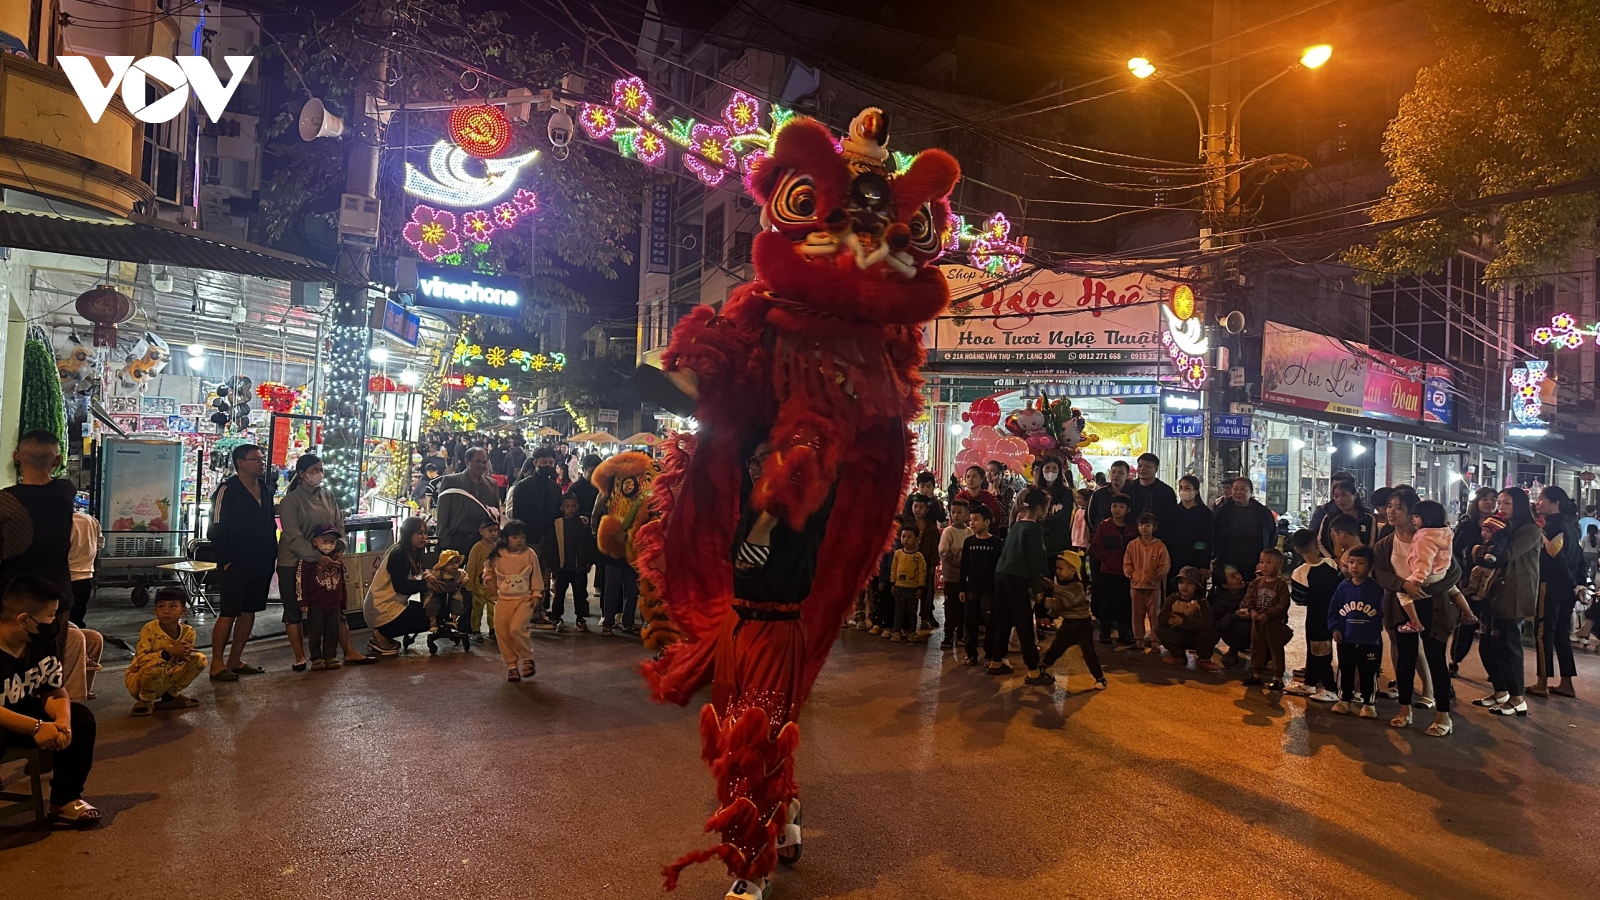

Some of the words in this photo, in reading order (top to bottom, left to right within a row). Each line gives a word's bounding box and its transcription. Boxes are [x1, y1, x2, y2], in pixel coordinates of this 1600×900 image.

[946, 268, 976, 283] Shop
[419, 275, 519, 307] vinaphone
[956, 279, 1064, 330] Ngọc
[1077, 273, 1144, 318] Huế
[959, 331, 997, 346] Hoa
[1002, 331, 1042, 346] Tươi
[1048, 330, 1097, 348] Nghệ
[1103, 330, 1159, 348] Thuật
[965, 352, 985, 360] HOÀNG
[985, 352, 998, 360] VĂN
[1026, 353, 1042, 361] LẠNG
[1043, 352, 1056, 360] SƠN
[1078, 352, 1094, 360] 0912
[1095, 352, 1107, 360] 271
[1284, 351, 1323, 386] Hoa
[1326, 359, 1357, 397] Len
[1390, 379, 1419, 412] Đoàn
[1225, 417, 1237, 425] PHỐ
[1183, 425, 1195, 434] LAI
